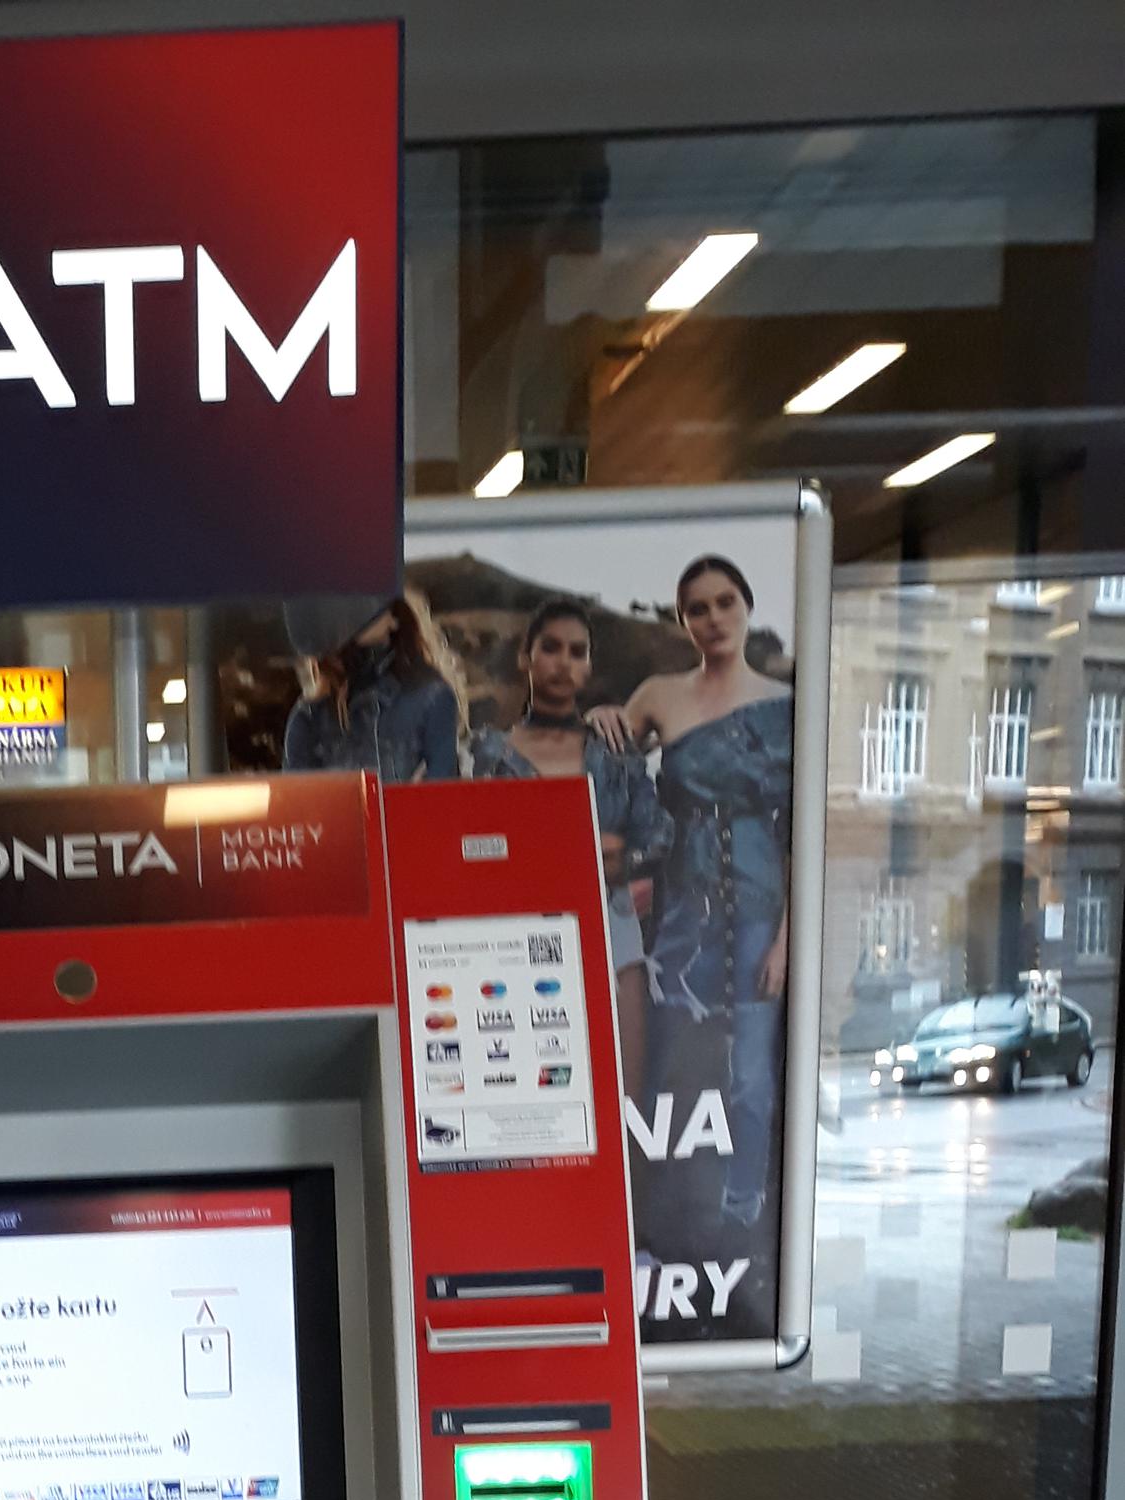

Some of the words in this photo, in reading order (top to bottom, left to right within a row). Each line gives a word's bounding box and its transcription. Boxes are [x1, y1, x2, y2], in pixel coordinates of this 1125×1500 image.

[220, 823, 324, 849] MONEY
[223, 847, 305, 872] BANK
[623, 1088, 735, 1161] NA
[57, 1294, 118, 1319] kartu
